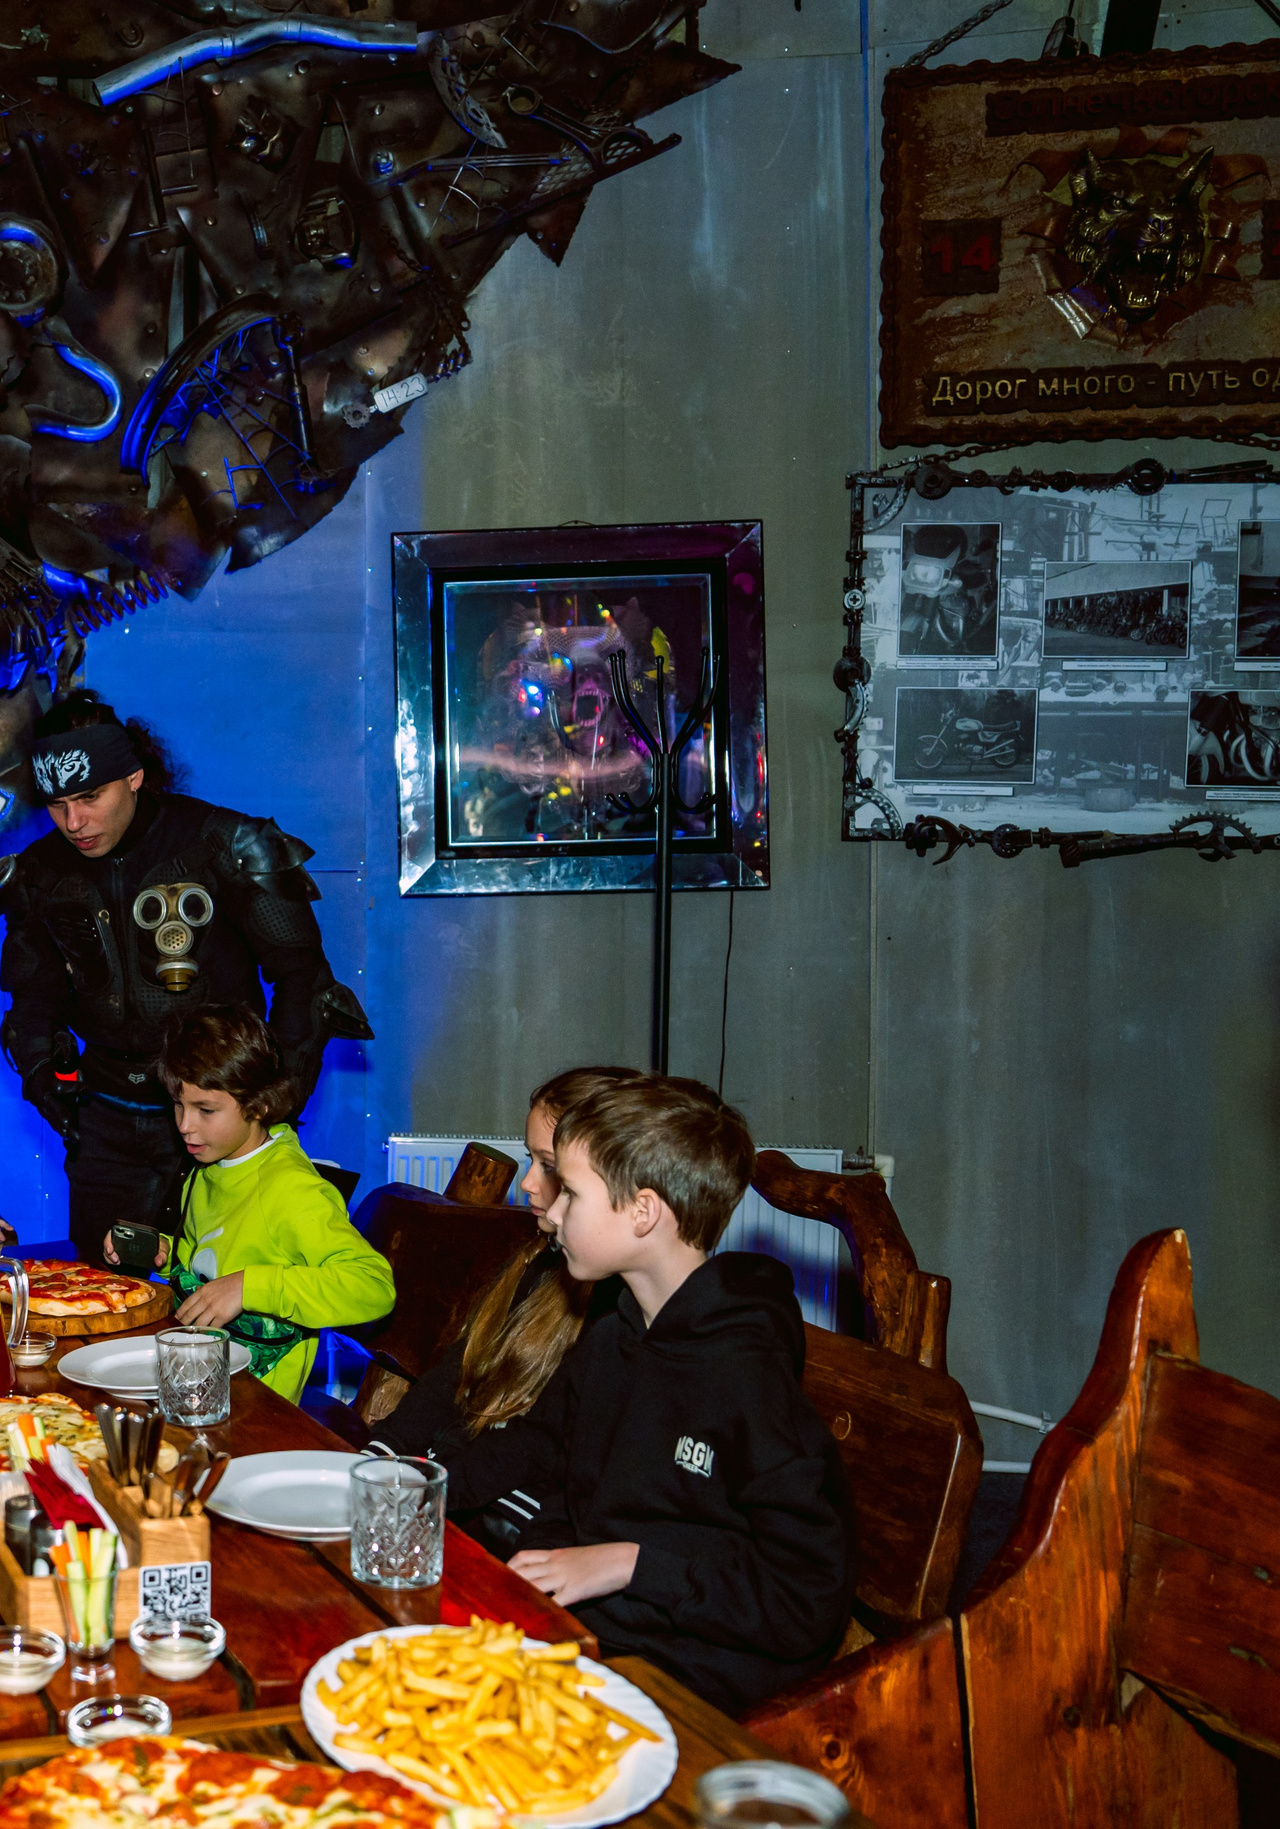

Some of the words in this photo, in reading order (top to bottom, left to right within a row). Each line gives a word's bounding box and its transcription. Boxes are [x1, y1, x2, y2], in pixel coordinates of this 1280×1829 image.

[930, 235, 996, 273] 14
[381, 376, 425, 408] 14:23
[932, 376, 1027, 407] Дорог
[1038, 374, 1136, 396] много
[1169, 370, 1241, 397] путь
